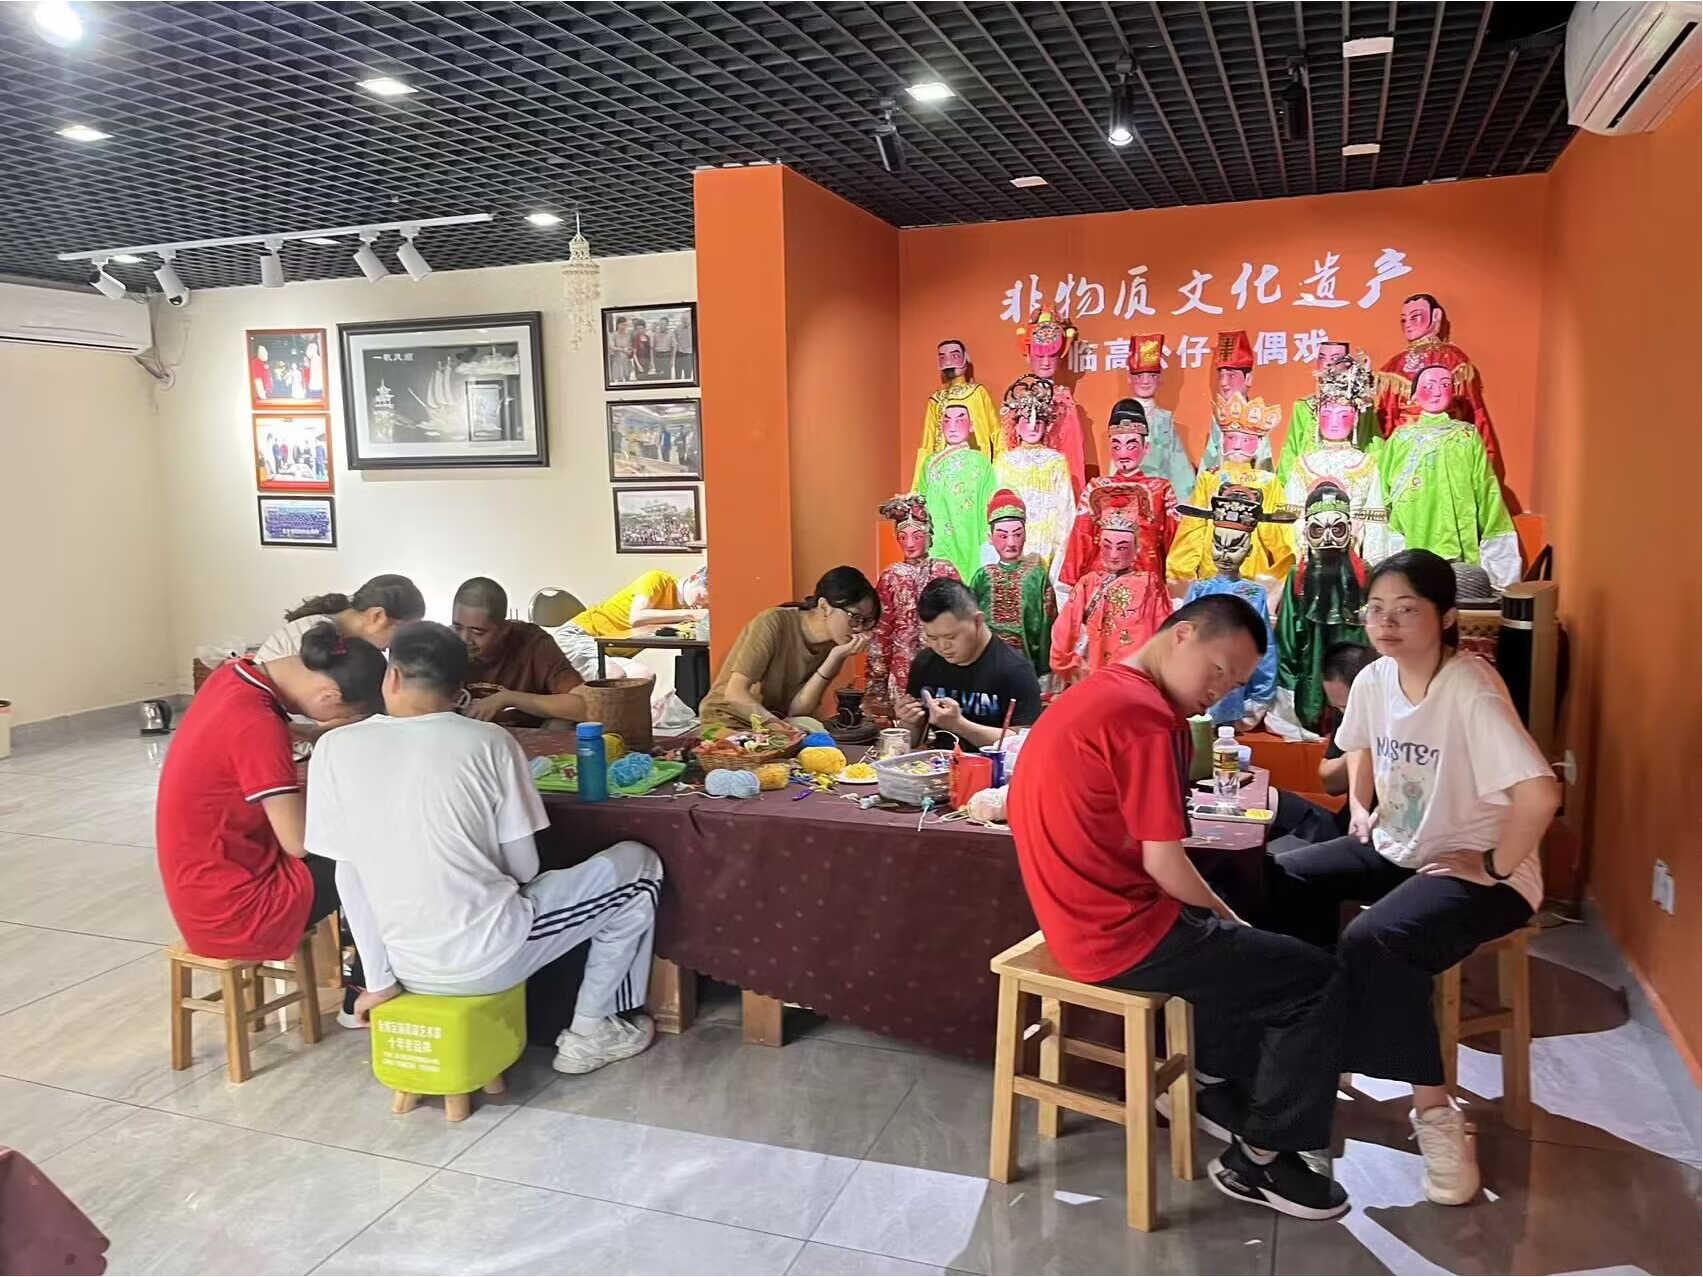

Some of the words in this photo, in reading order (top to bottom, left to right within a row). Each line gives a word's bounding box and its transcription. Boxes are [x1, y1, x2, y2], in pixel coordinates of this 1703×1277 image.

[999, 247, 1413, 324] 非物质文化遗产
[1068, 329, 1328, 373] 临高仔偶戏
